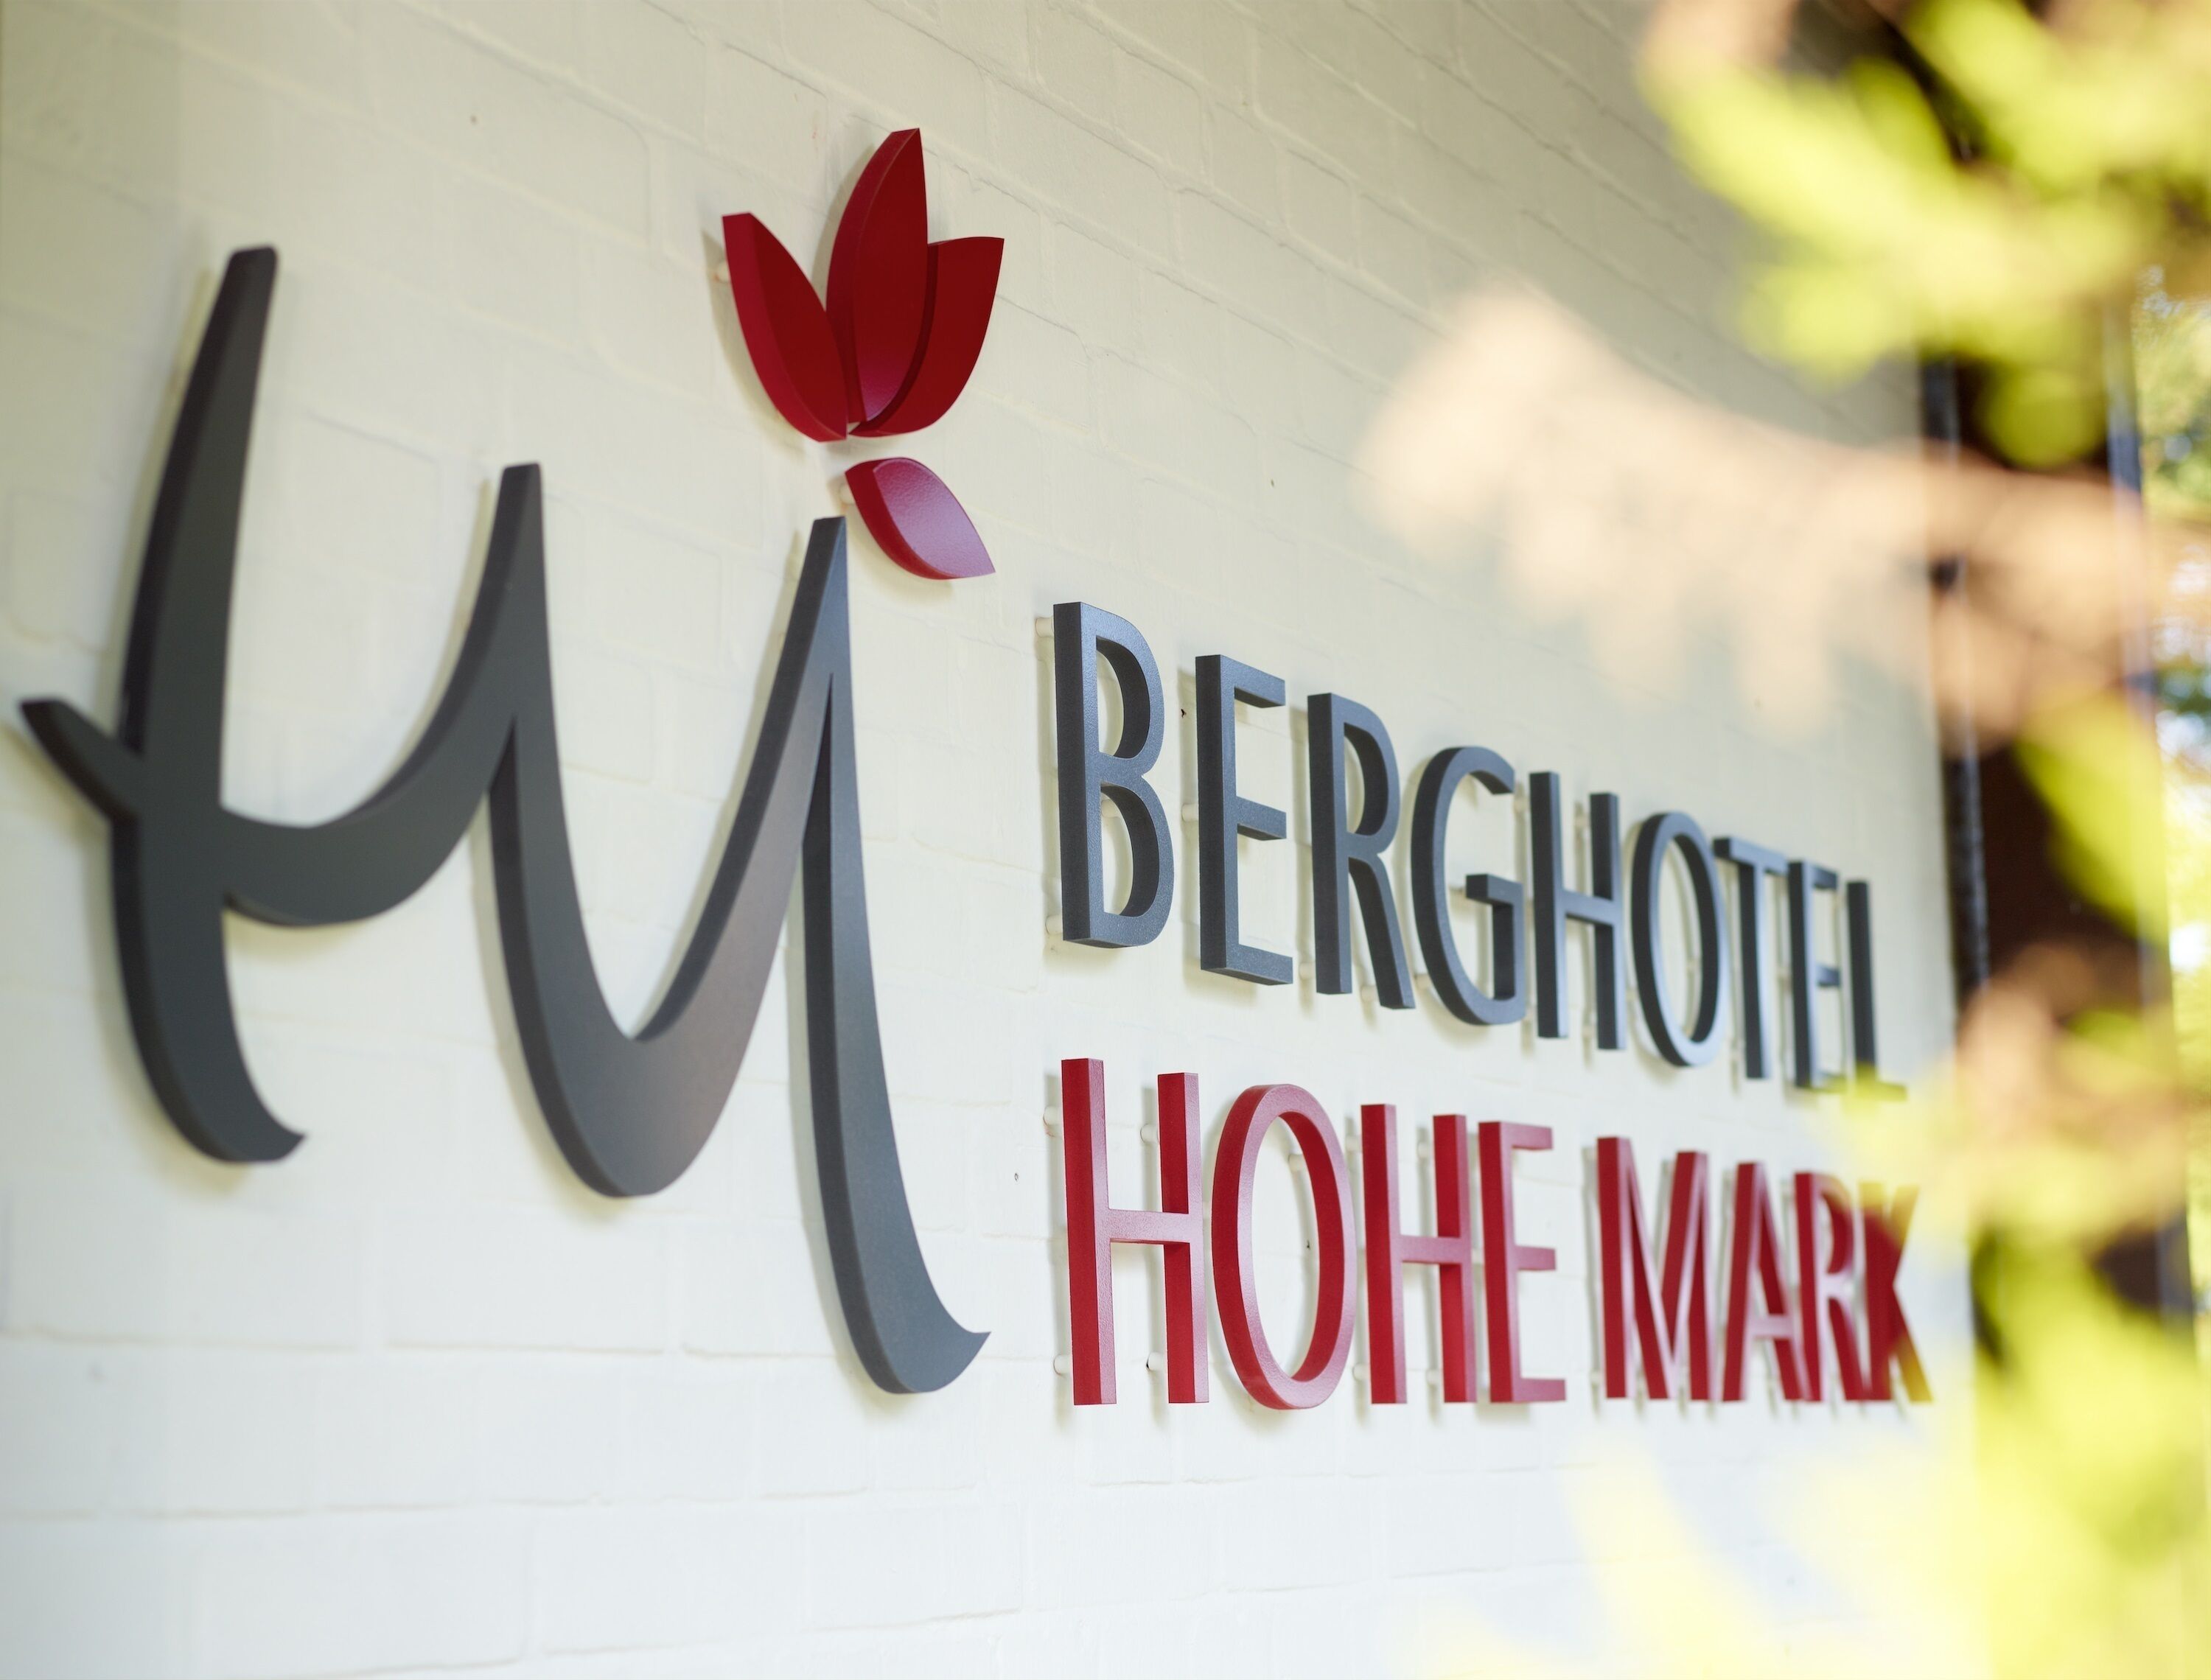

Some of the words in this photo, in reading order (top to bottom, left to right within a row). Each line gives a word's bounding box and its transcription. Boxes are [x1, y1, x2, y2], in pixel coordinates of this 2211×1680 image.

[1052, 601, 1907, 1101] BERGHOTEL
[1061, 1057, 1568, 1410] HOHE
[1596, 1135, 1934, 1404] MARK
